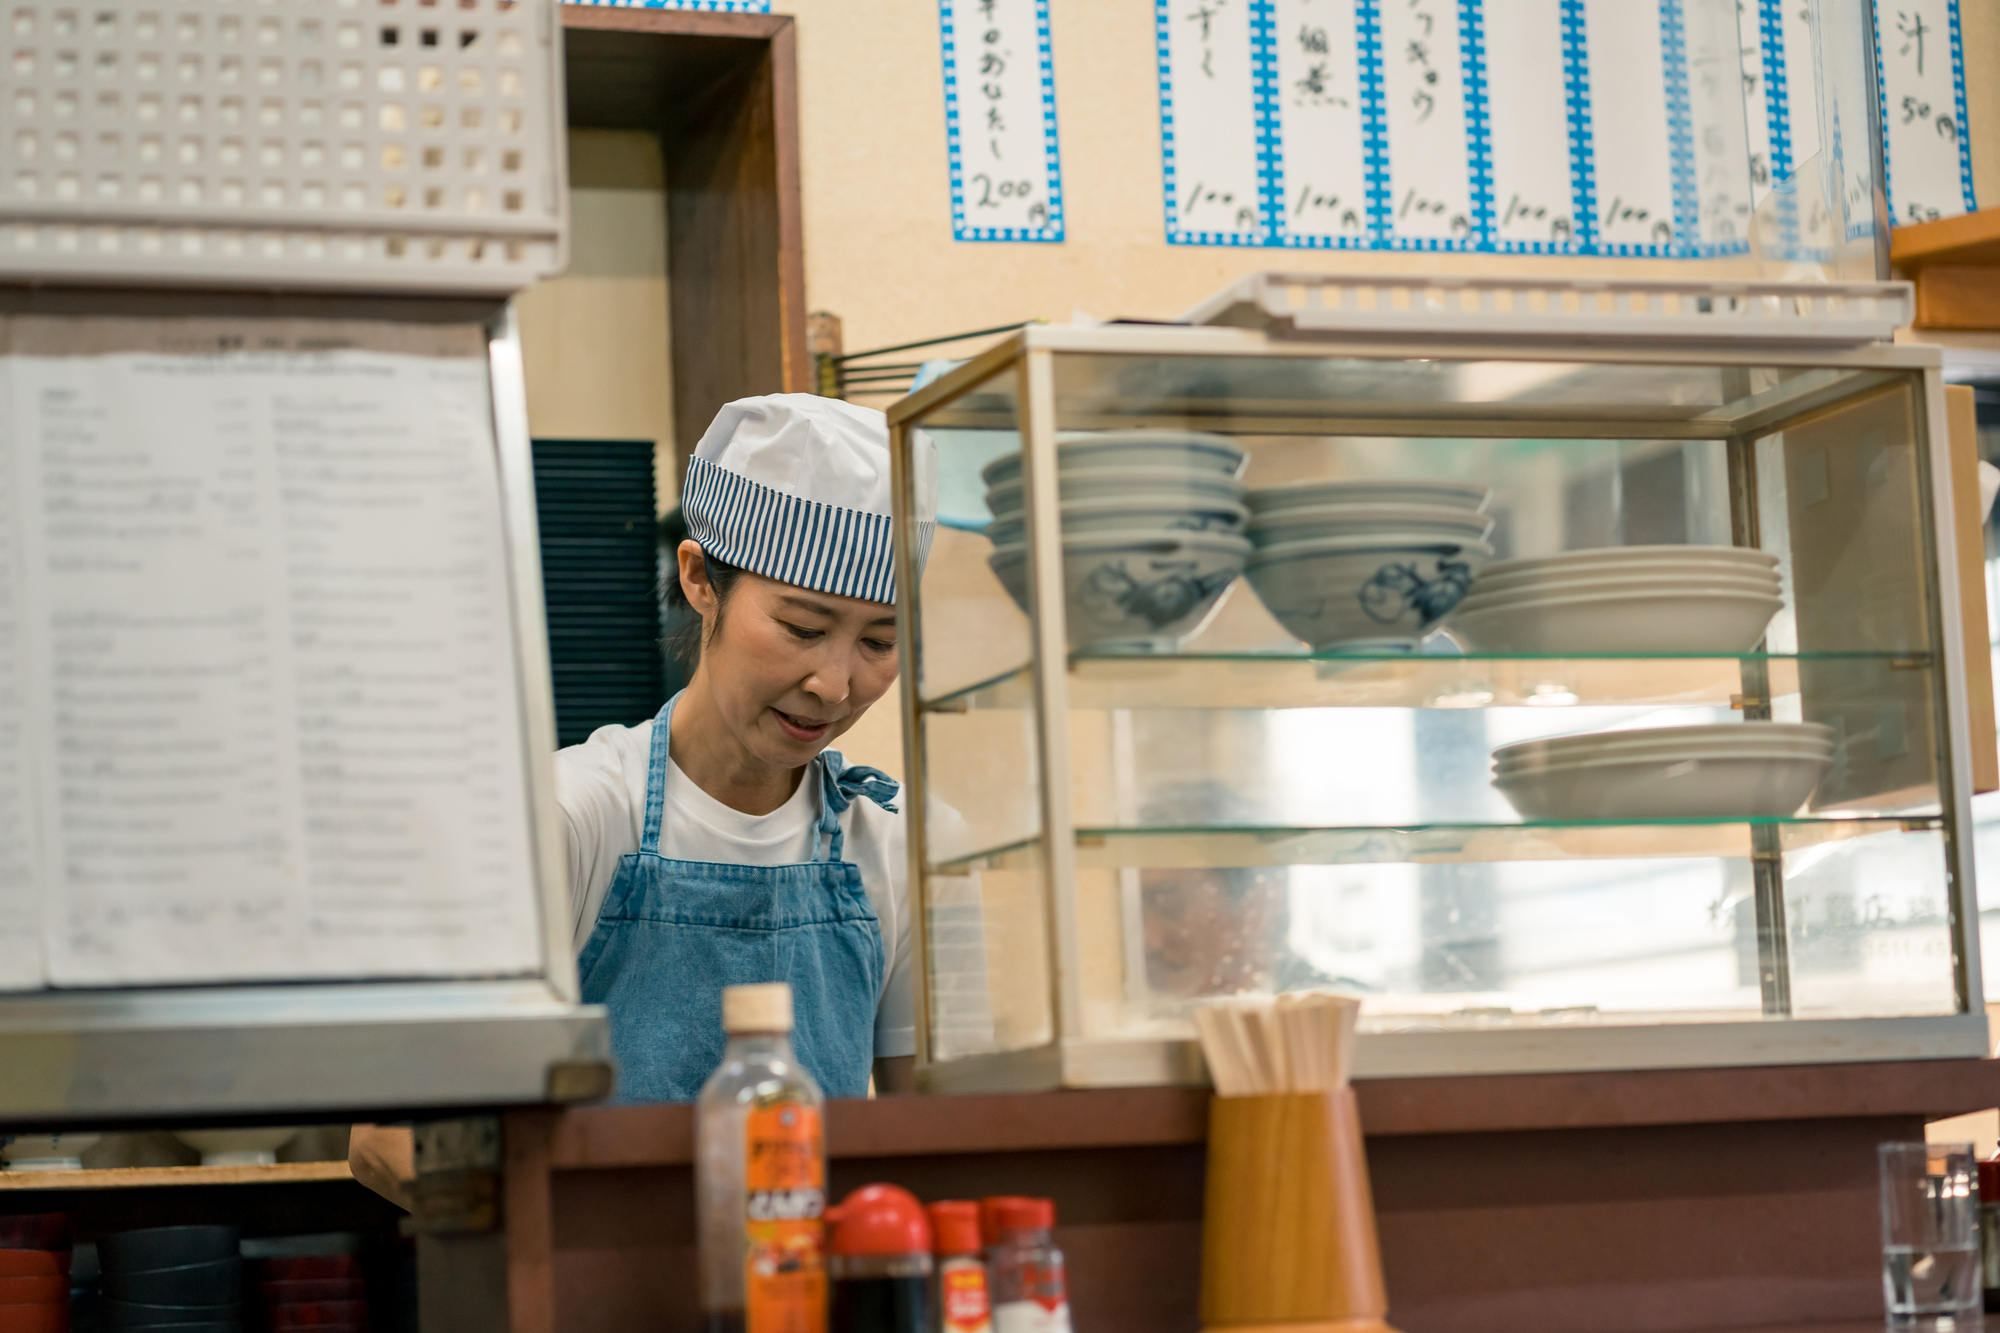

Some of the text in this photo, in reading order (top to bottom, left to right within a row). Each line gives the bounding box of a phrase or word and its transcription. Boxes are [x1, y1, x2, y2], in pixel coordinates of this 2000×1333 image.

[1294, 0, 1350, 108] 佃煮
[1405, 0, 1438, 125] ッキョウ
[1896, 9, 1930, 78] 汁
[972, 173, 1049, 228] 200円
[1185, 183, 1256, 228] 100円
[1295, 185, 1359, 231] 100円
[1400, 188, 1471, 237] 100円
[1504, 194, 1573, 240] 100円
[1605, 196, 1674, 242] 100円
